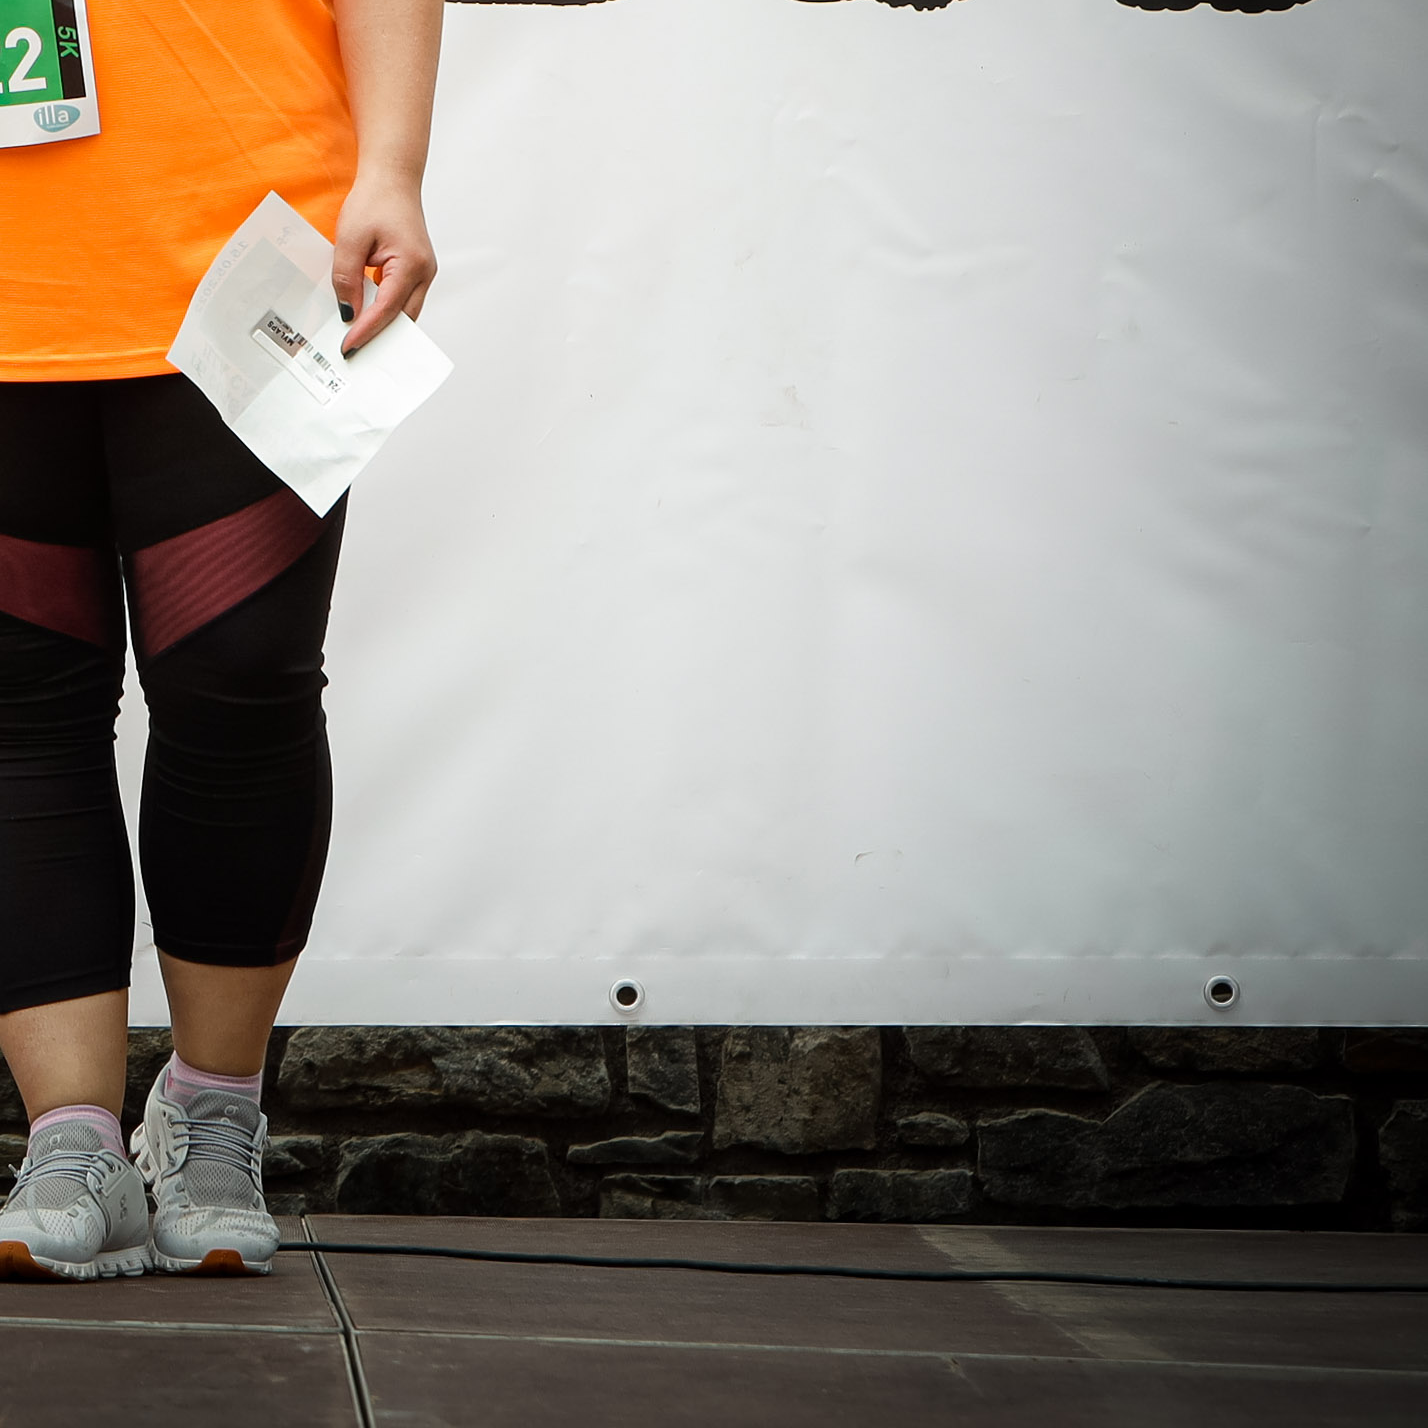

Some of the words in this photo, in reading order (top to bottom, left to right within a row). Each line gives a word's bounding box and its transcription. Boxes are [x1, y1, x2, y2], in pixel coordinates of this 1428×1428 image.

[56, 25, 80, 59] 5K
[37, 104, 70, 126] illa
[267, 320, 295, 347] MYLAPS
